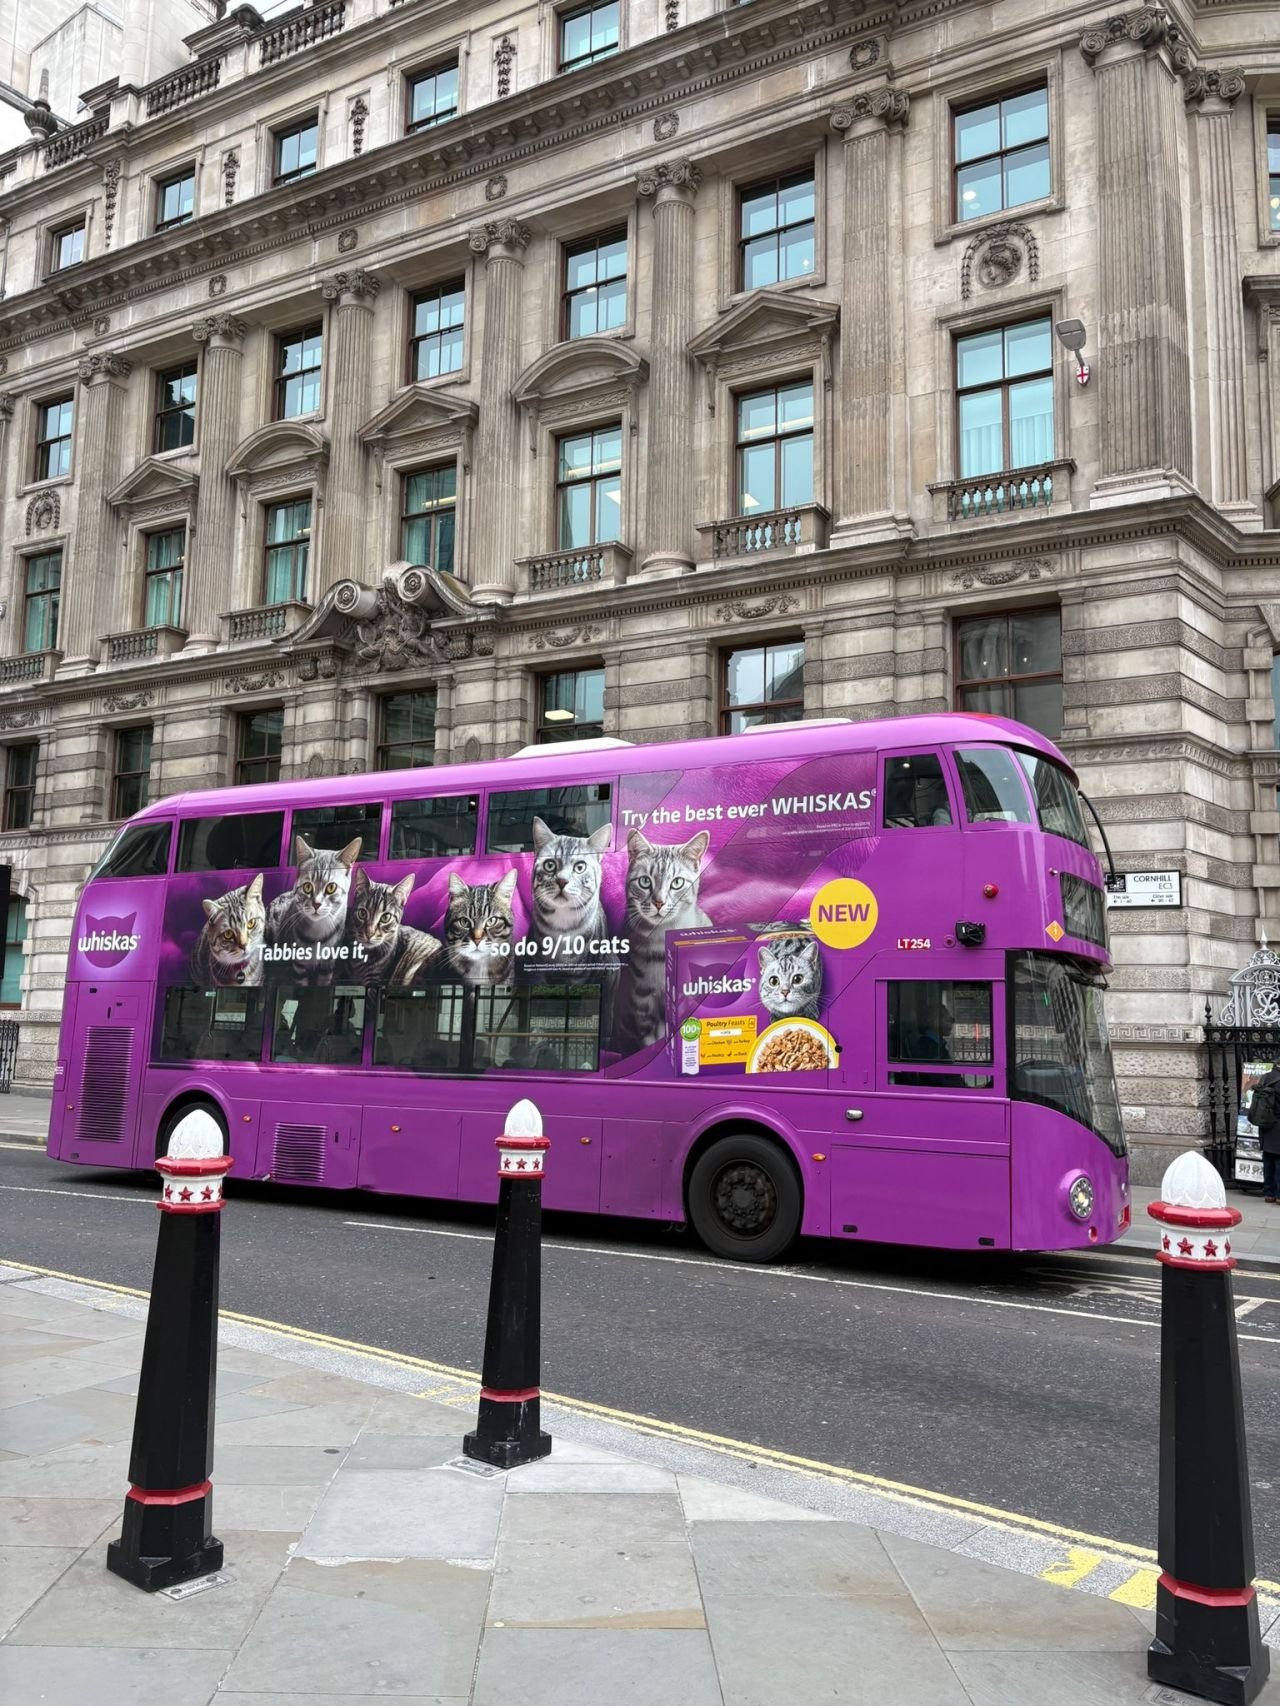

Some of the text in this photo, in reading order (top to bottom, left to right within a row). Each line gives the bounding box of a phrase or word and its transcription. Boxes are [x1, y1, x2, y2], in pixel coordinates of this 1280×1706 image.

[621, 809, 648, 829] Try
[652, 806, 680, 824] the
[685, 804, 723, 822] best
[727, 802, 767, 818] ever
[818, 904, 870, 922] NEW
[257, 941, 369, 963] Tabbies love it,
[490, 935, 630, 959] so do 9/10 cats
[897, 938, 931, 949] LT254
